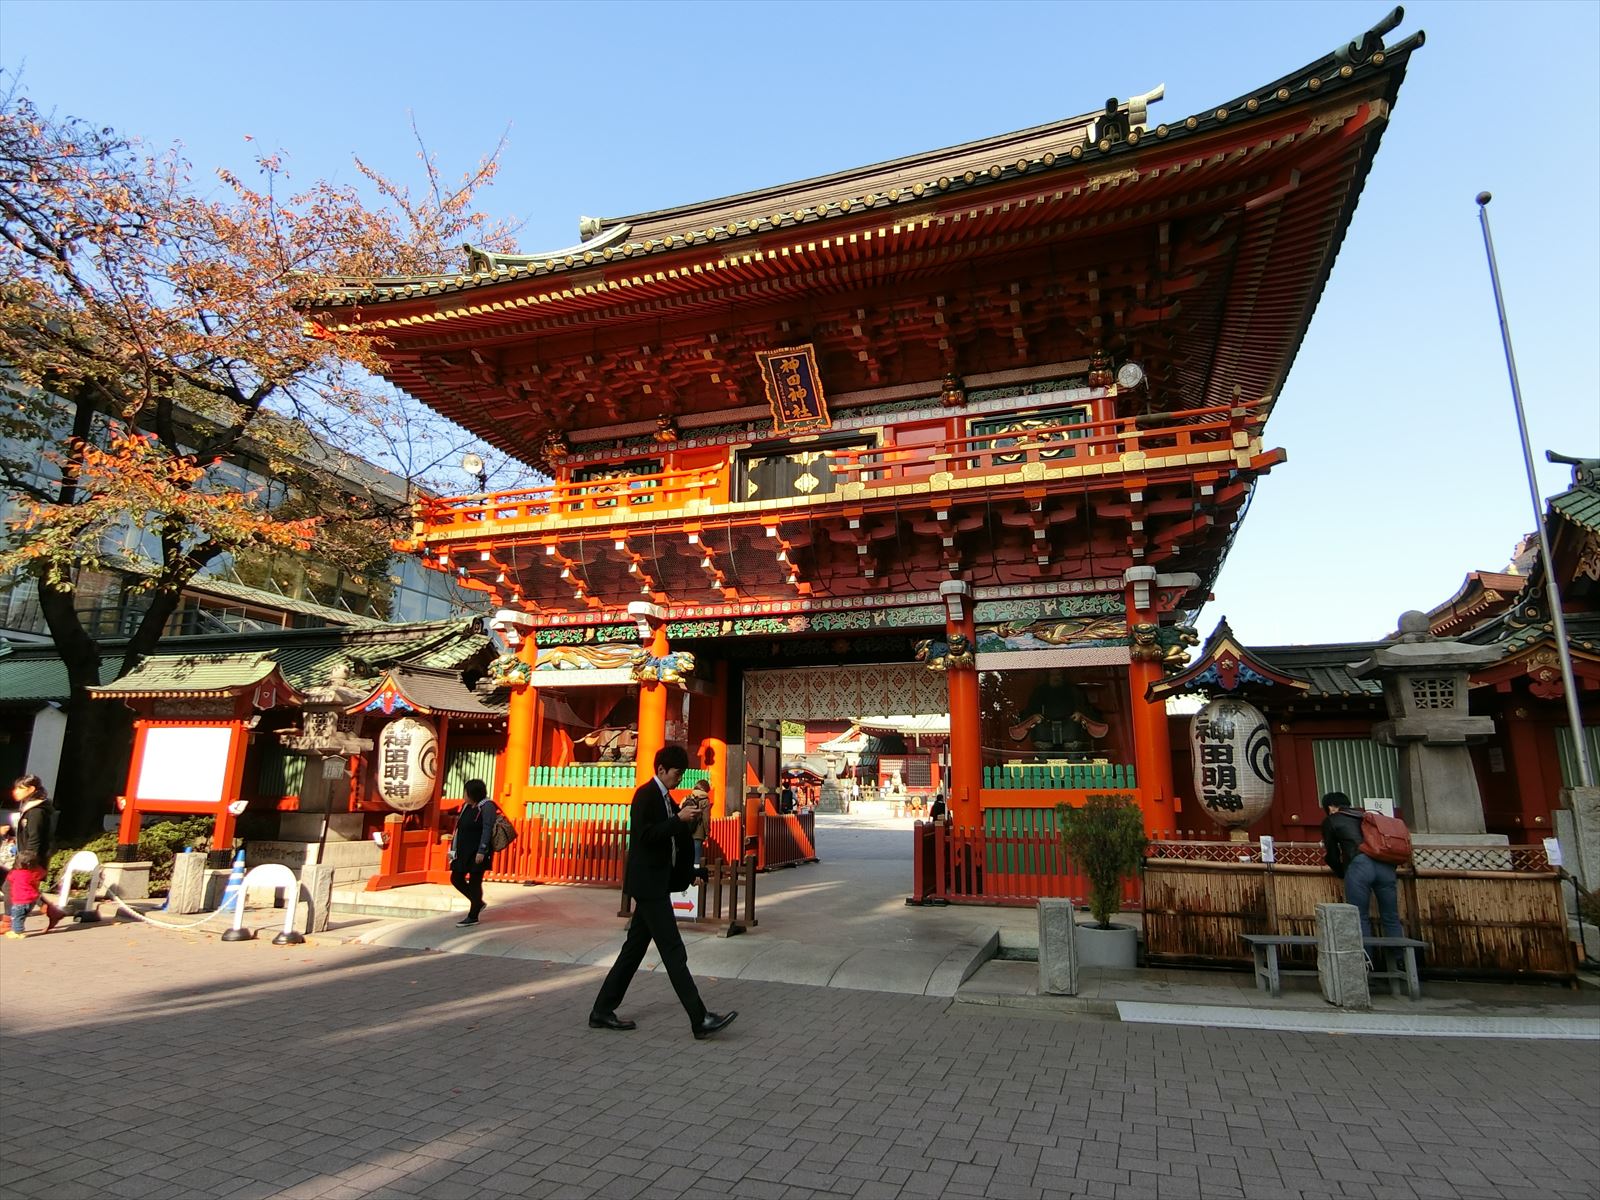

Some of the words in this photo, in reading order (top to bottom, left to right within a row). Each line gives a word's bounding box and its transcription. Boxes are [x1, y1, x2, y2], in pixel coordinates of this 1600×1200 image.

[780, 357, 812, 418] 神田神社
[383, 731, 411, 798] 神田明神
[1195, 717, 1243, 812] 神田明神
